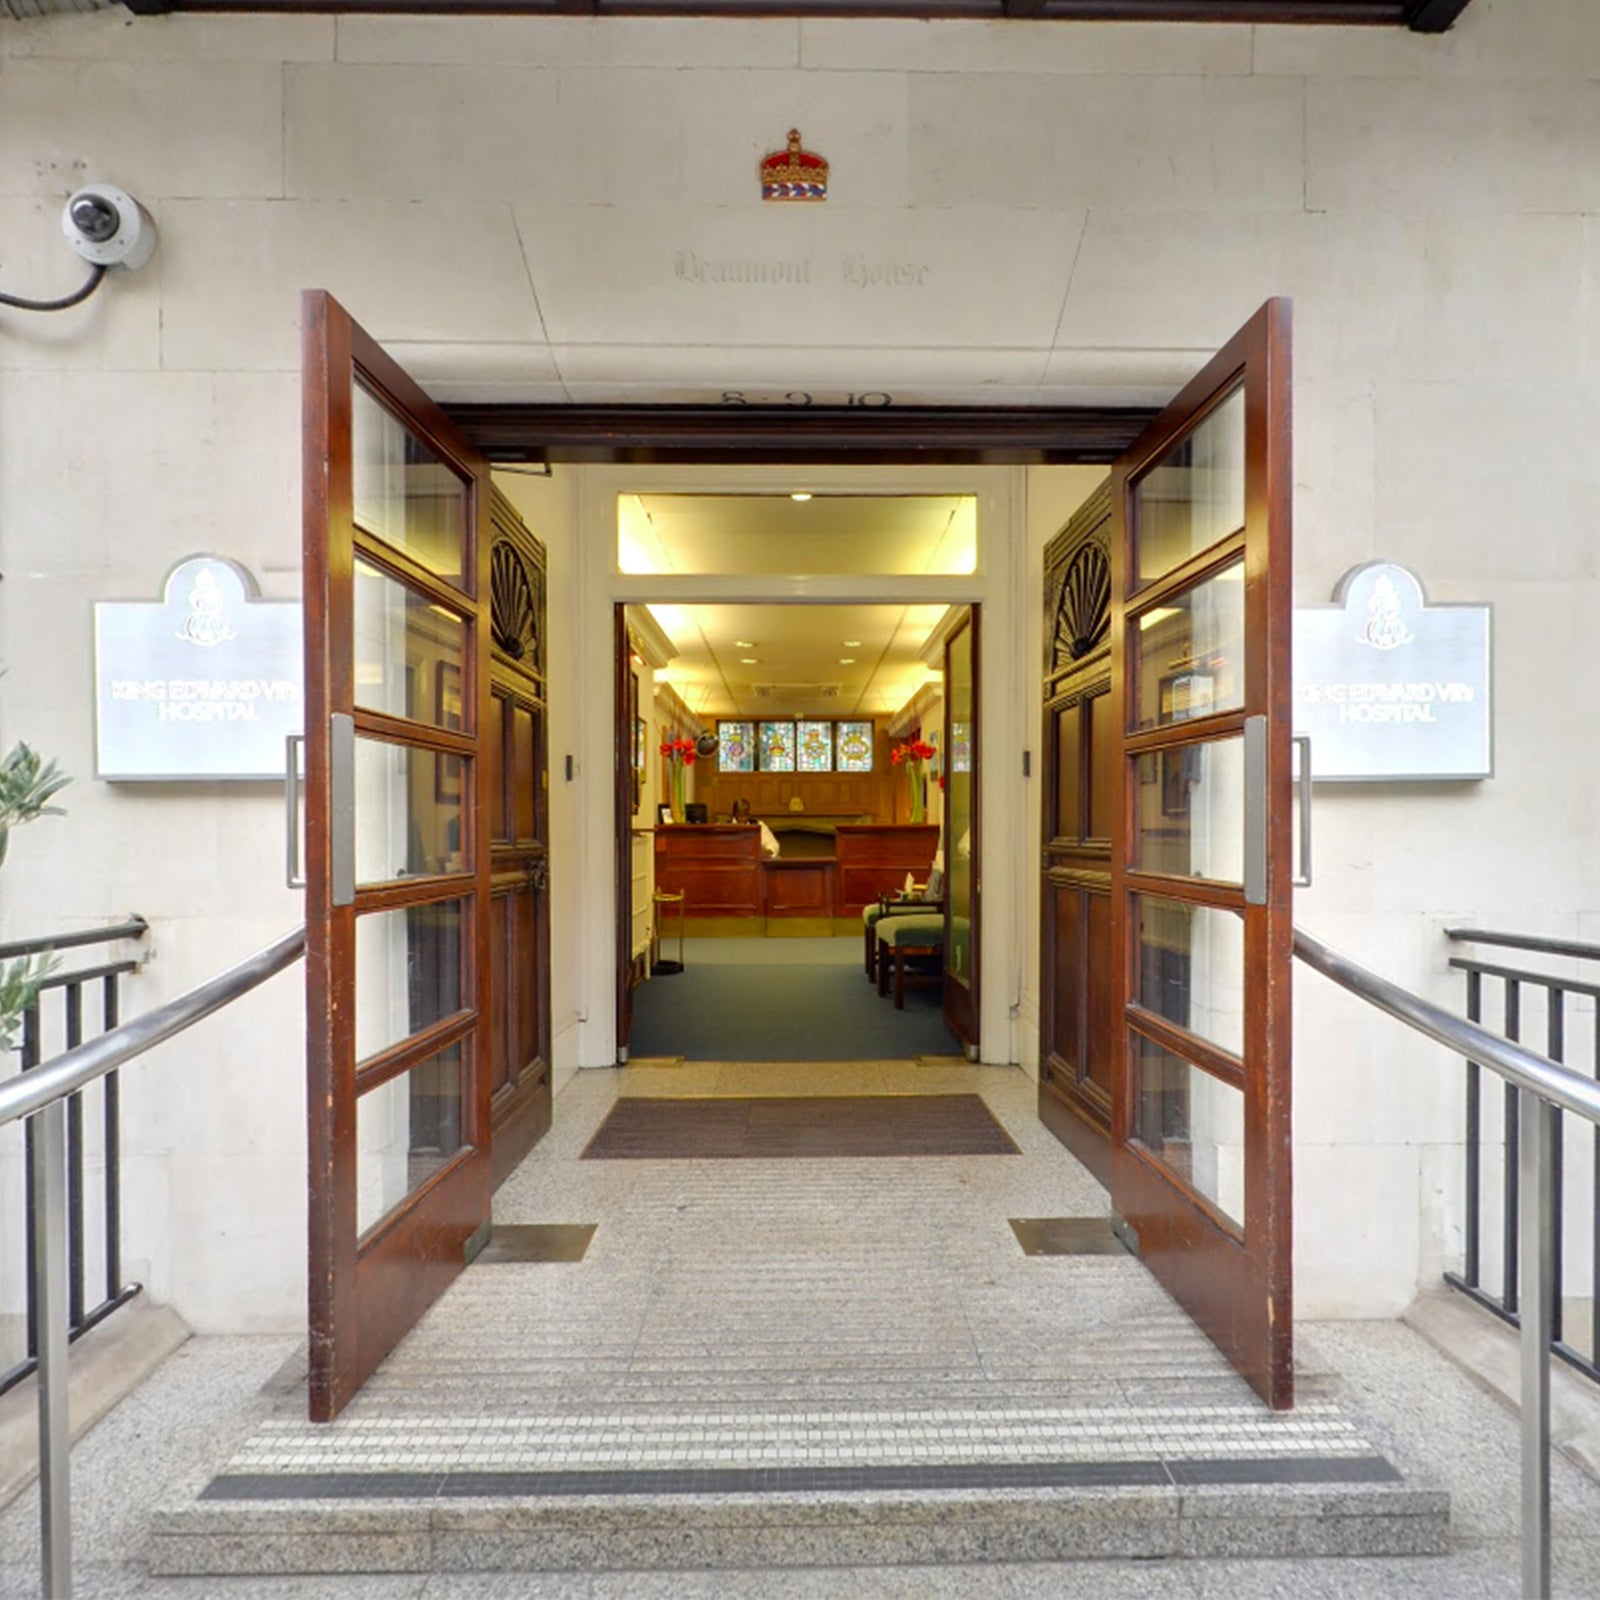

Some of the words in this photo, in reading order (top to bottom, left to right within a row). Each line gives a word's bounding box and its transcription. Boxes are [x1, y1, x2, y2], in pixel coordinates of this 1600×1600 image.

[673, 250, 813, 285] Beaumont
[112, 680, 167, 700] KING
[169, 680, 261, 700] EDWARD
[1295, 683, 1348, 703] KING
[1348, 683, 1436, 703] EDWARD
[159, 701, 262, 721] HOSPITAL
[1339, 704, 1437, 723] HOSPITAL
